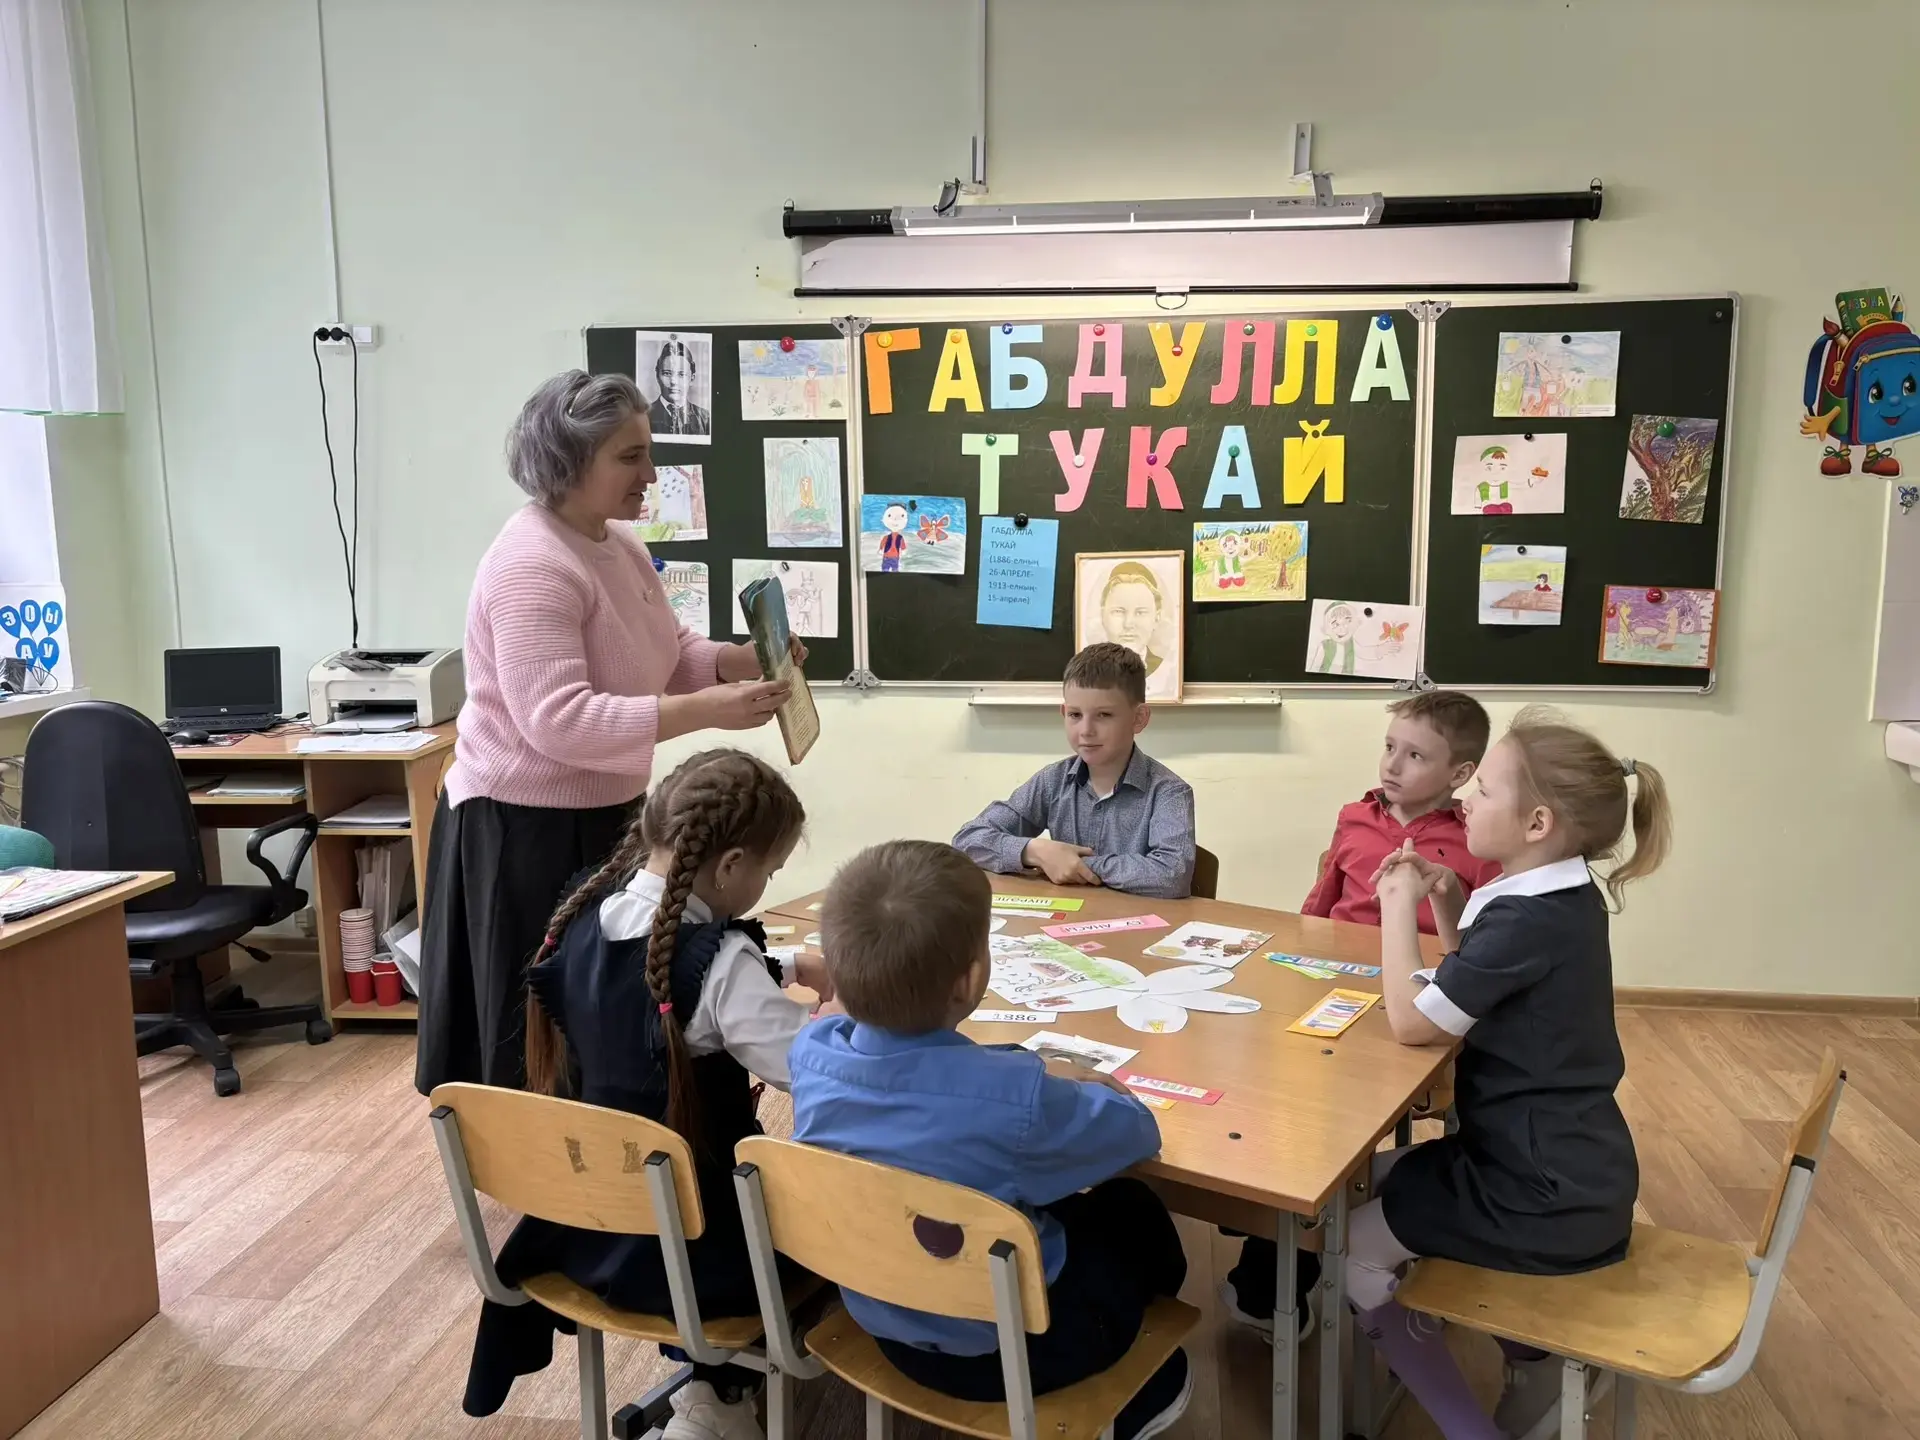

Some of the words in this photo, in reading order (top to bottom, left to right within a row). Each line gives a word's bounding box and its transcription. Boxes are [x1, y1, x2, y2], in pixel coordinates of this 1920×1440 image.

[864, 316, 1410, 415] ГАБДУЛЛА
[961, 419, 1345, 515] ТУКАЙ
[991, 526, 1033, 536] ГАБДУЛЛА
[990, 540, 1017, 549] ТУКАЙ
[992, 1013, 1037, 1022] 1886
